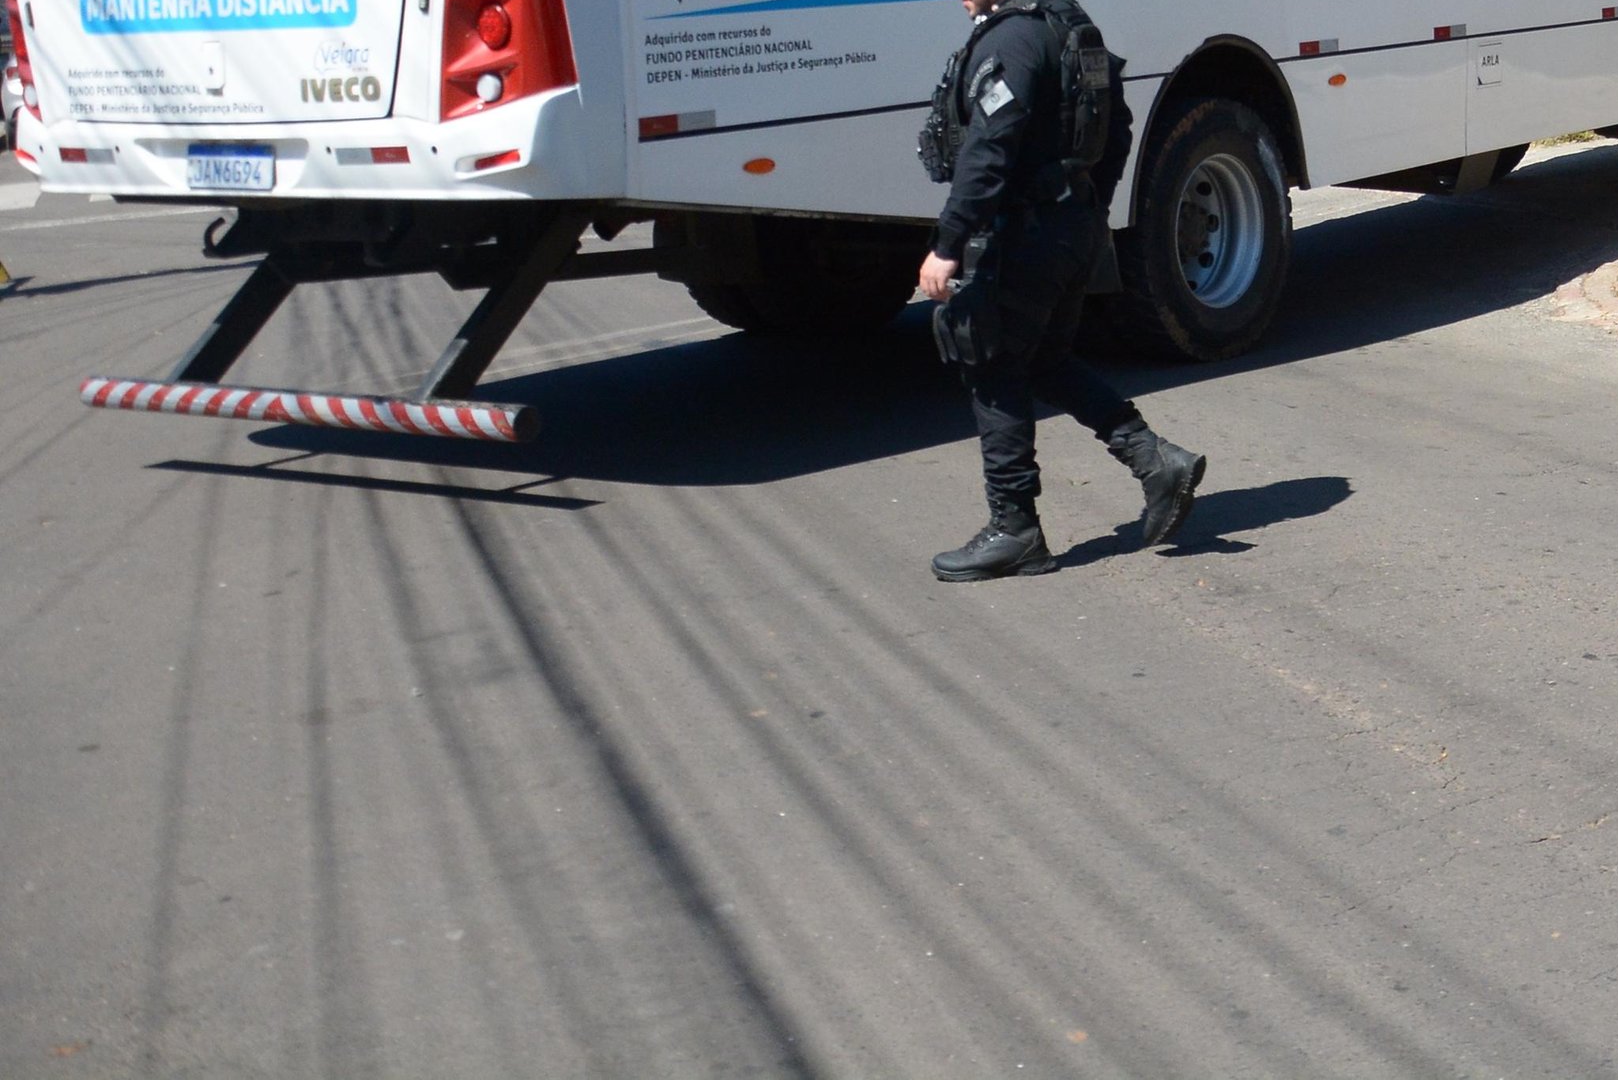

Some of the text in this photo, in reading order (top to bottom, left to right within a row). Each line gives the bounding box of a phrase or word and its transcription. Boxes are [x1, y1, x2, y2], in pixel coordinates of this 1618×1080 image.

[644, 25, 771, 47] Adquirido com recursos do
[646, 39, 814, 65] FUNDO PENITENCIÁRIO NACIONAL
[122, 68, 154, 78] recursos
[155, 66, 165, 78] do
[646, 72, 683, 85] DEPEN
[690, 65, 741, 80] Ministério
[742, 62, 754, 74] da
[756, 58, 789, 73] Justiça
[797, 56, 843, 72] Segurança
[845, 51, 877, 64] Pública
[68, 82, 201, 97] FUNDO PENITENCIÁRIO NACIONAL
[300, 76, 382, 103] IVECO
[69, 103, 95, 114] DEPEN
